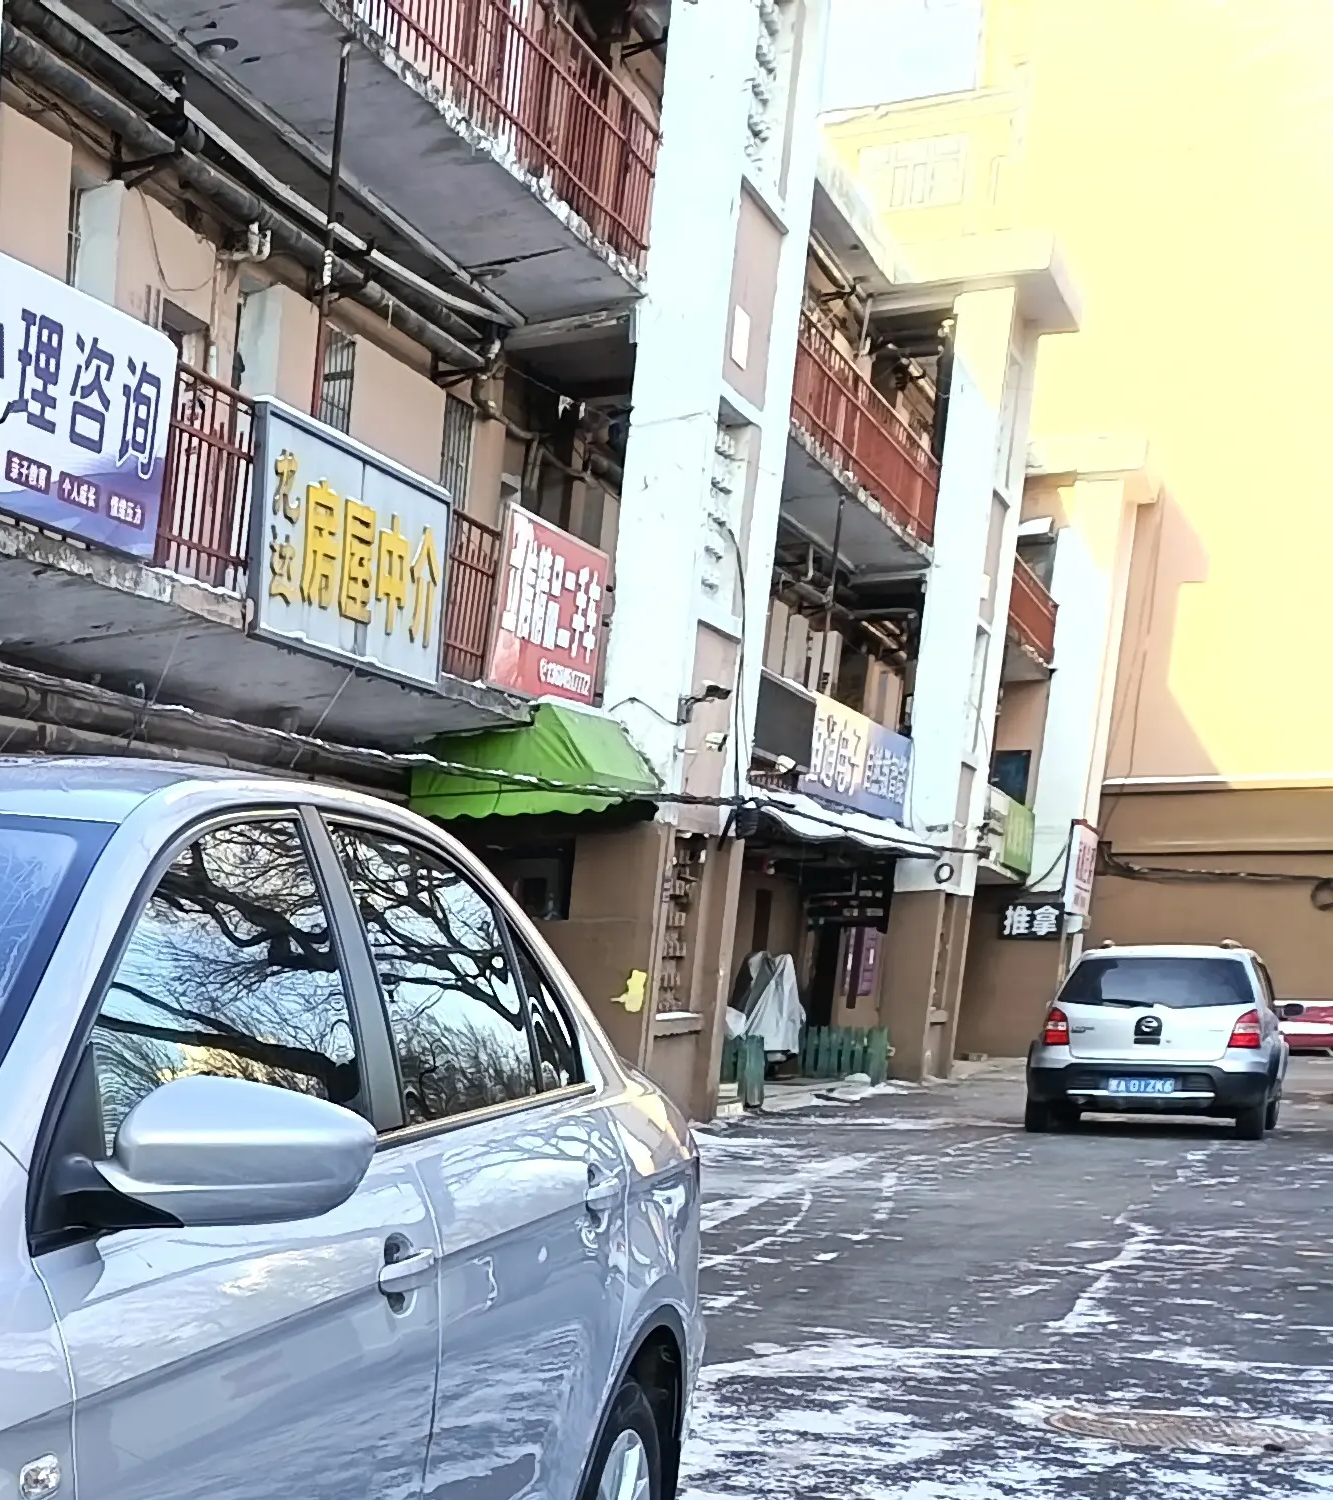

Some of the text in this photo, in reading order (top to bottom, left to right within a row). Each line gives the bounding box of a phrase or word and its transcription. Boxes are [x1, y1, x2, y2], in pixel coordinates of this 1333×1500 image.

[62, 476, 98, 509] 个人成长
[300, 477, 441, 649] 房屋中介
[1002, 904, 1060, 936] 推拿
